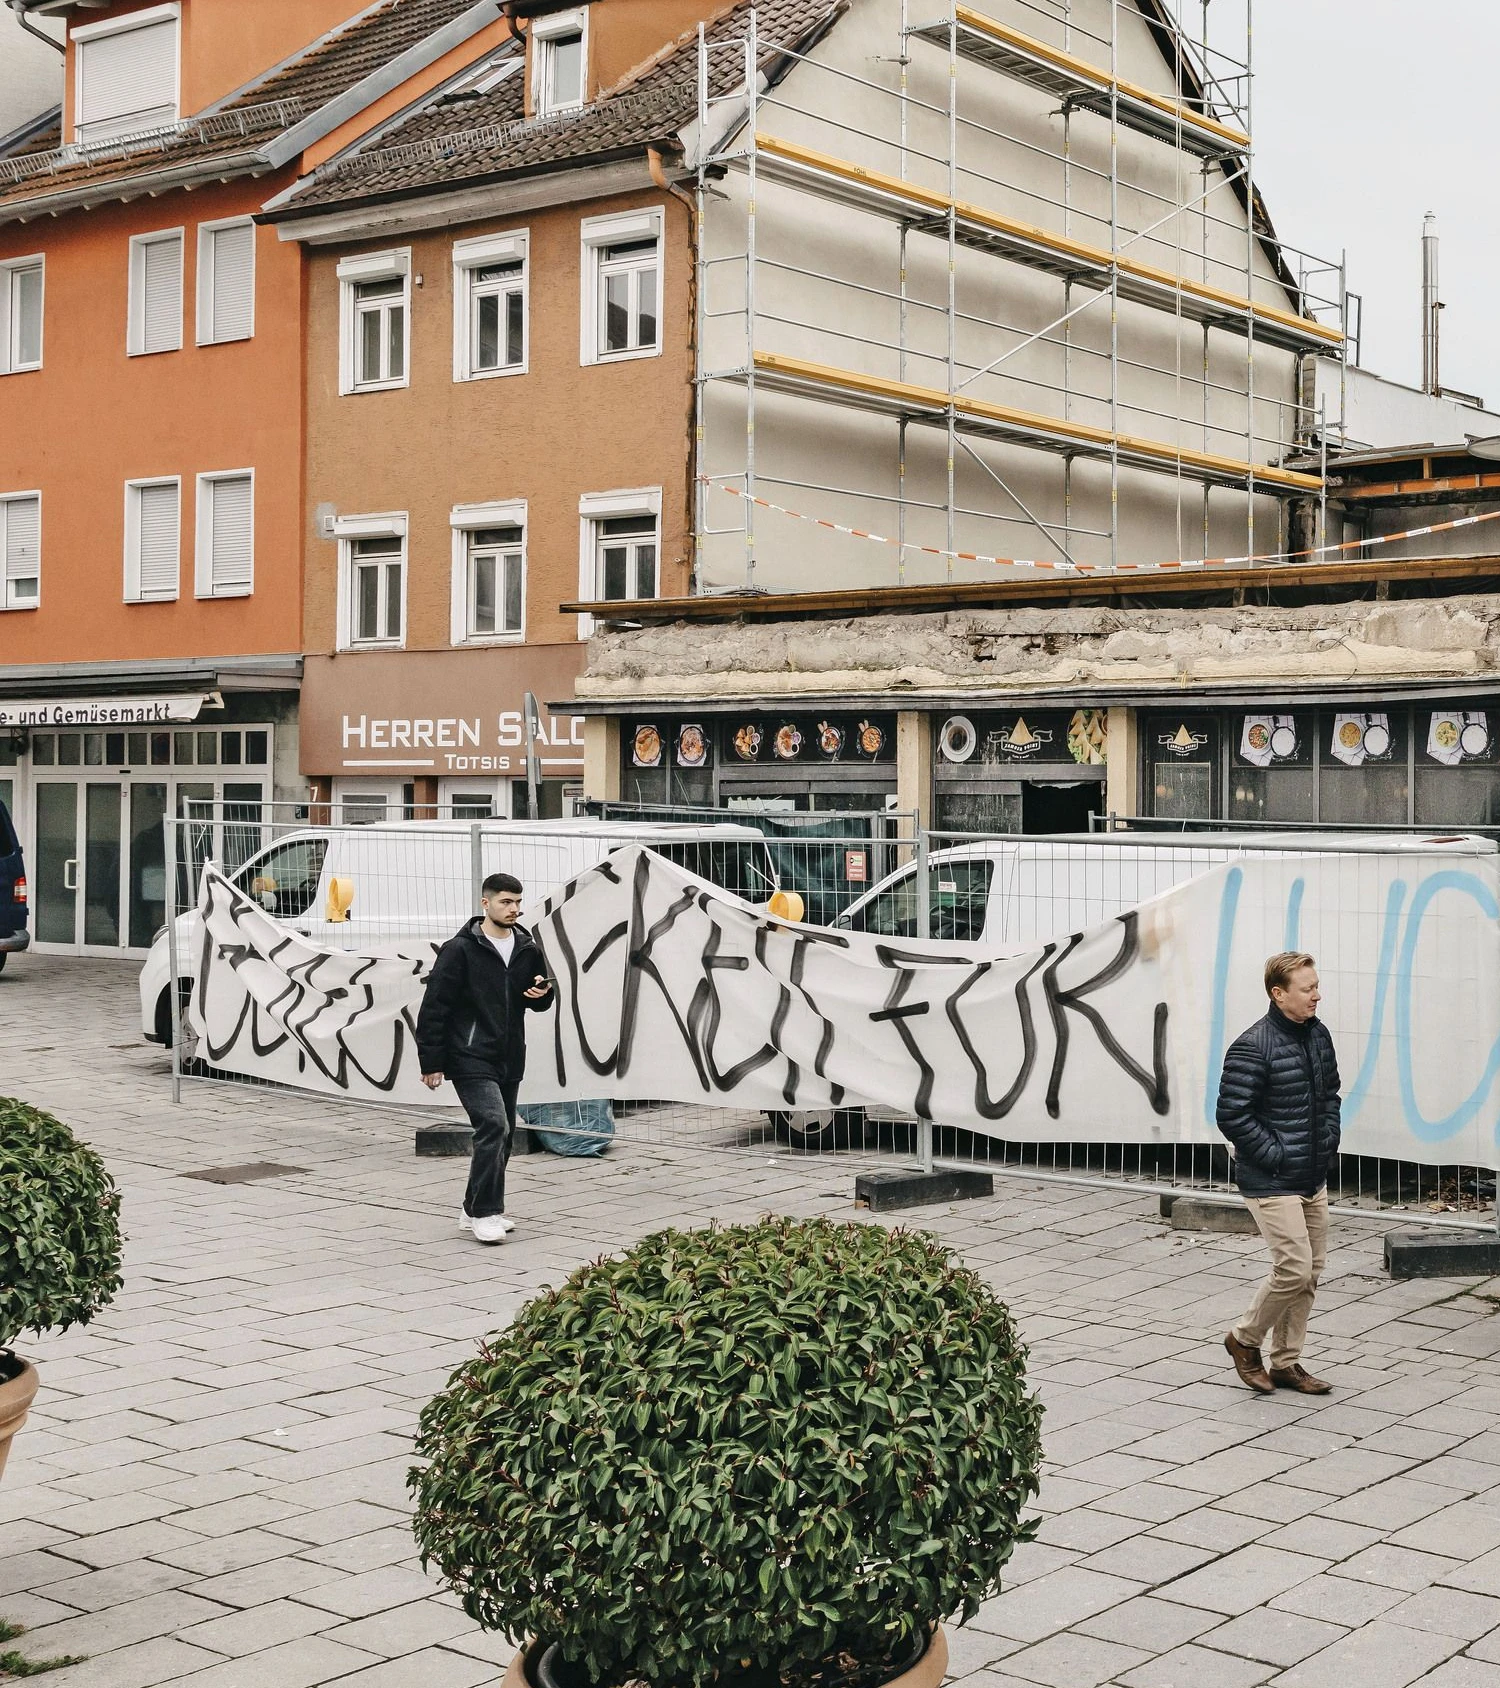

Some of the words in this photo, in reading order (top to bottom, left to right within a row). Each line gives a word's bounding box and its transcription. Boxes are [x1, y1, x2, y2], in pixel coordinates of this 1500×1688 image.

[19, 706, 48, 724] und
[53, 702, 170, 724] Gemüsemarkt
[342, 715, 481, 748] HERREN
[444, 753, 510, 769] TOTSIS
[310, 786, 319, 802] 7
